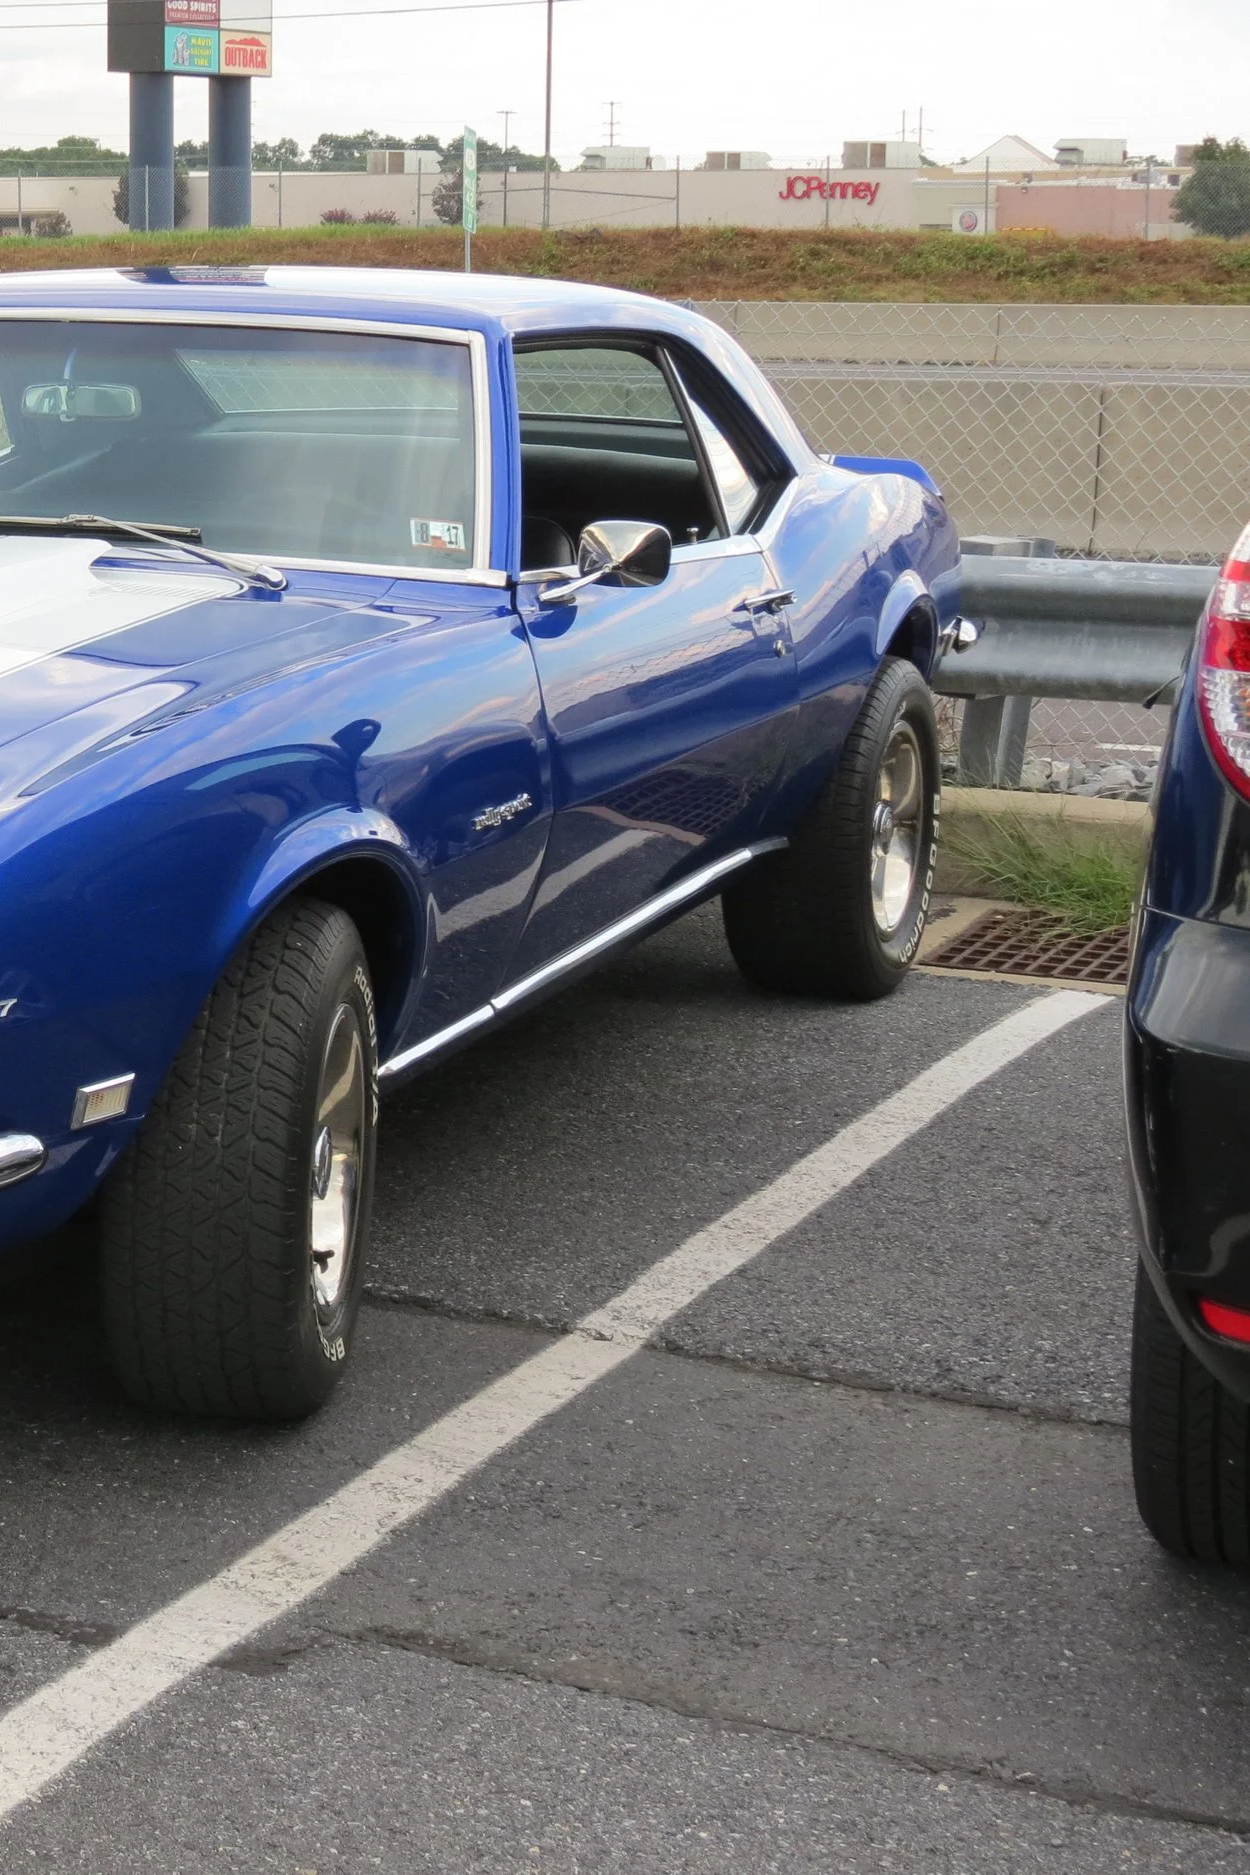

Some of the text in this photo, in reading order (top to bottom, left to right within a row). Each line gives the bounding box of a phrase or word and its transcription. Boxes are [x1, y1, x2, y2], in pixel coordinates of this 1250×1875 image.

[190, 1, 217, 13] SPIRITS
[191, 36, 212, 46] MAVIS
[225, 47, 267, 69] OUTBACK
[779, 176, 880, 206] JCPenney
[446, 525, 459, 546] 17
